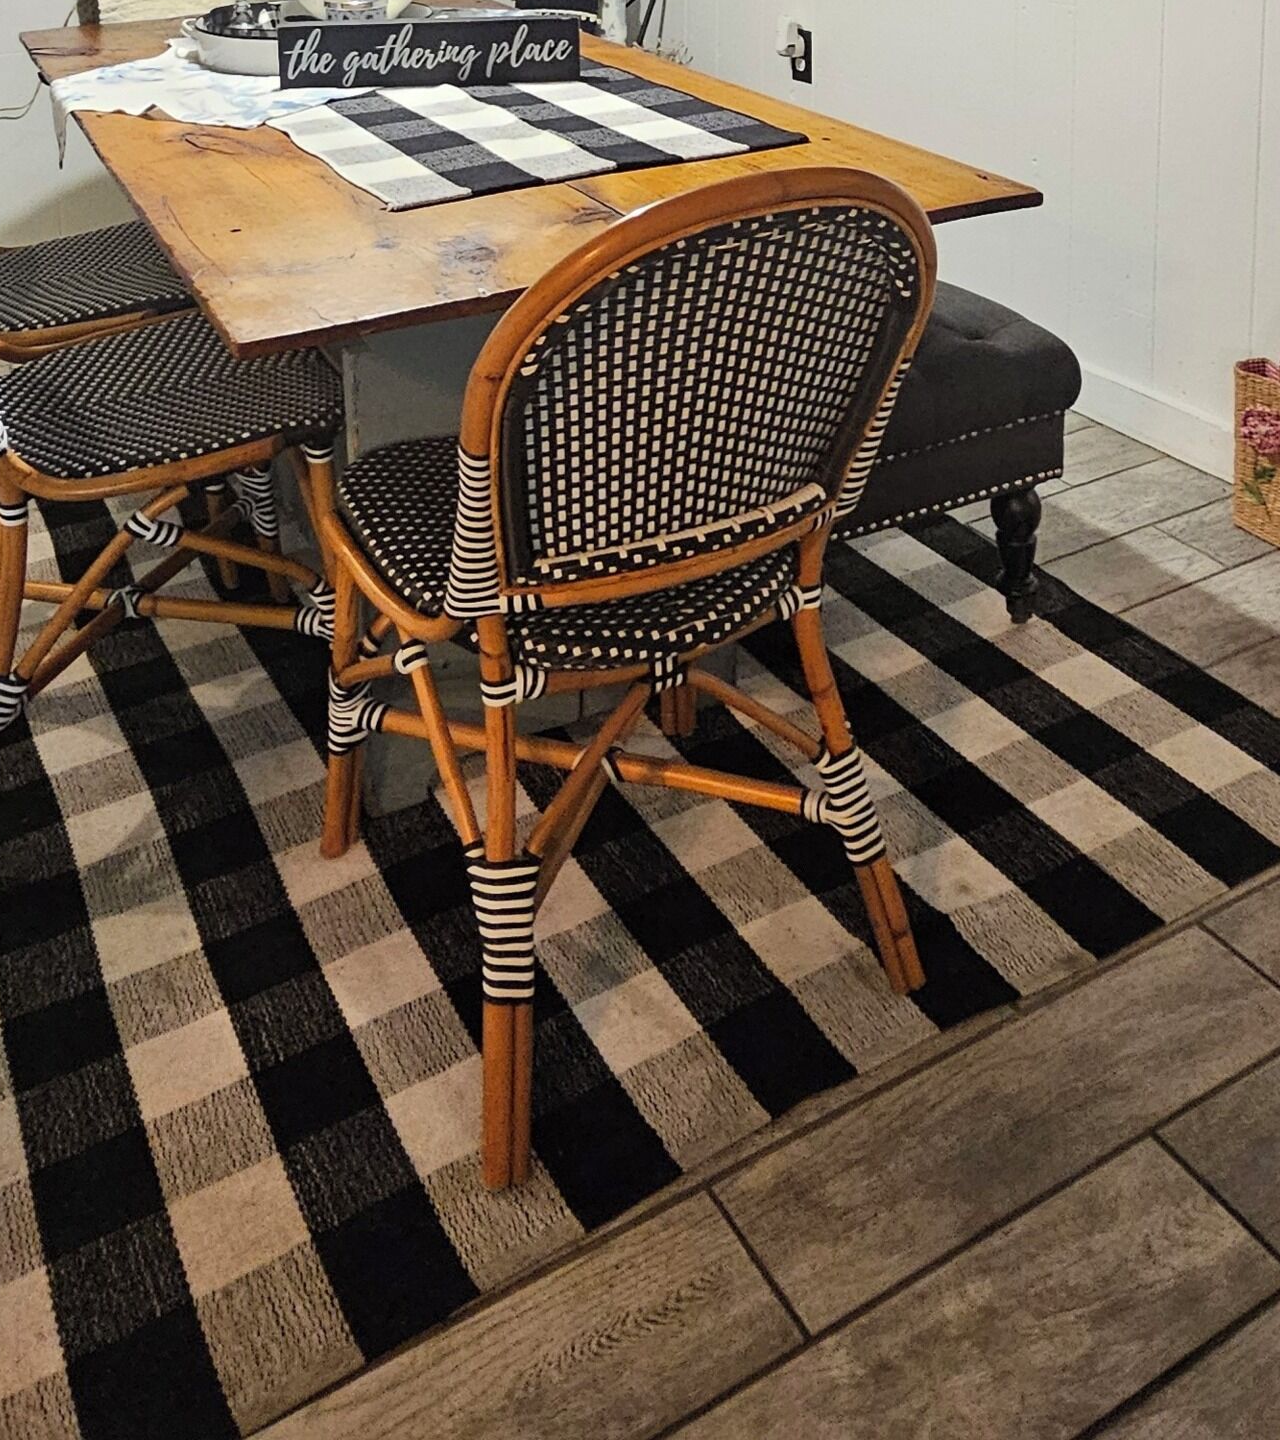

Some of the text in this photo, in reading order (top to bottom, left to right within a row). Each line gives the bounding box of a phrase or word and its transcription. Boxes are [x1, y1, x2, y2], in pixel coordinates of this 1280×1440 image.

[283, 24, 572, 87] the gathering place
